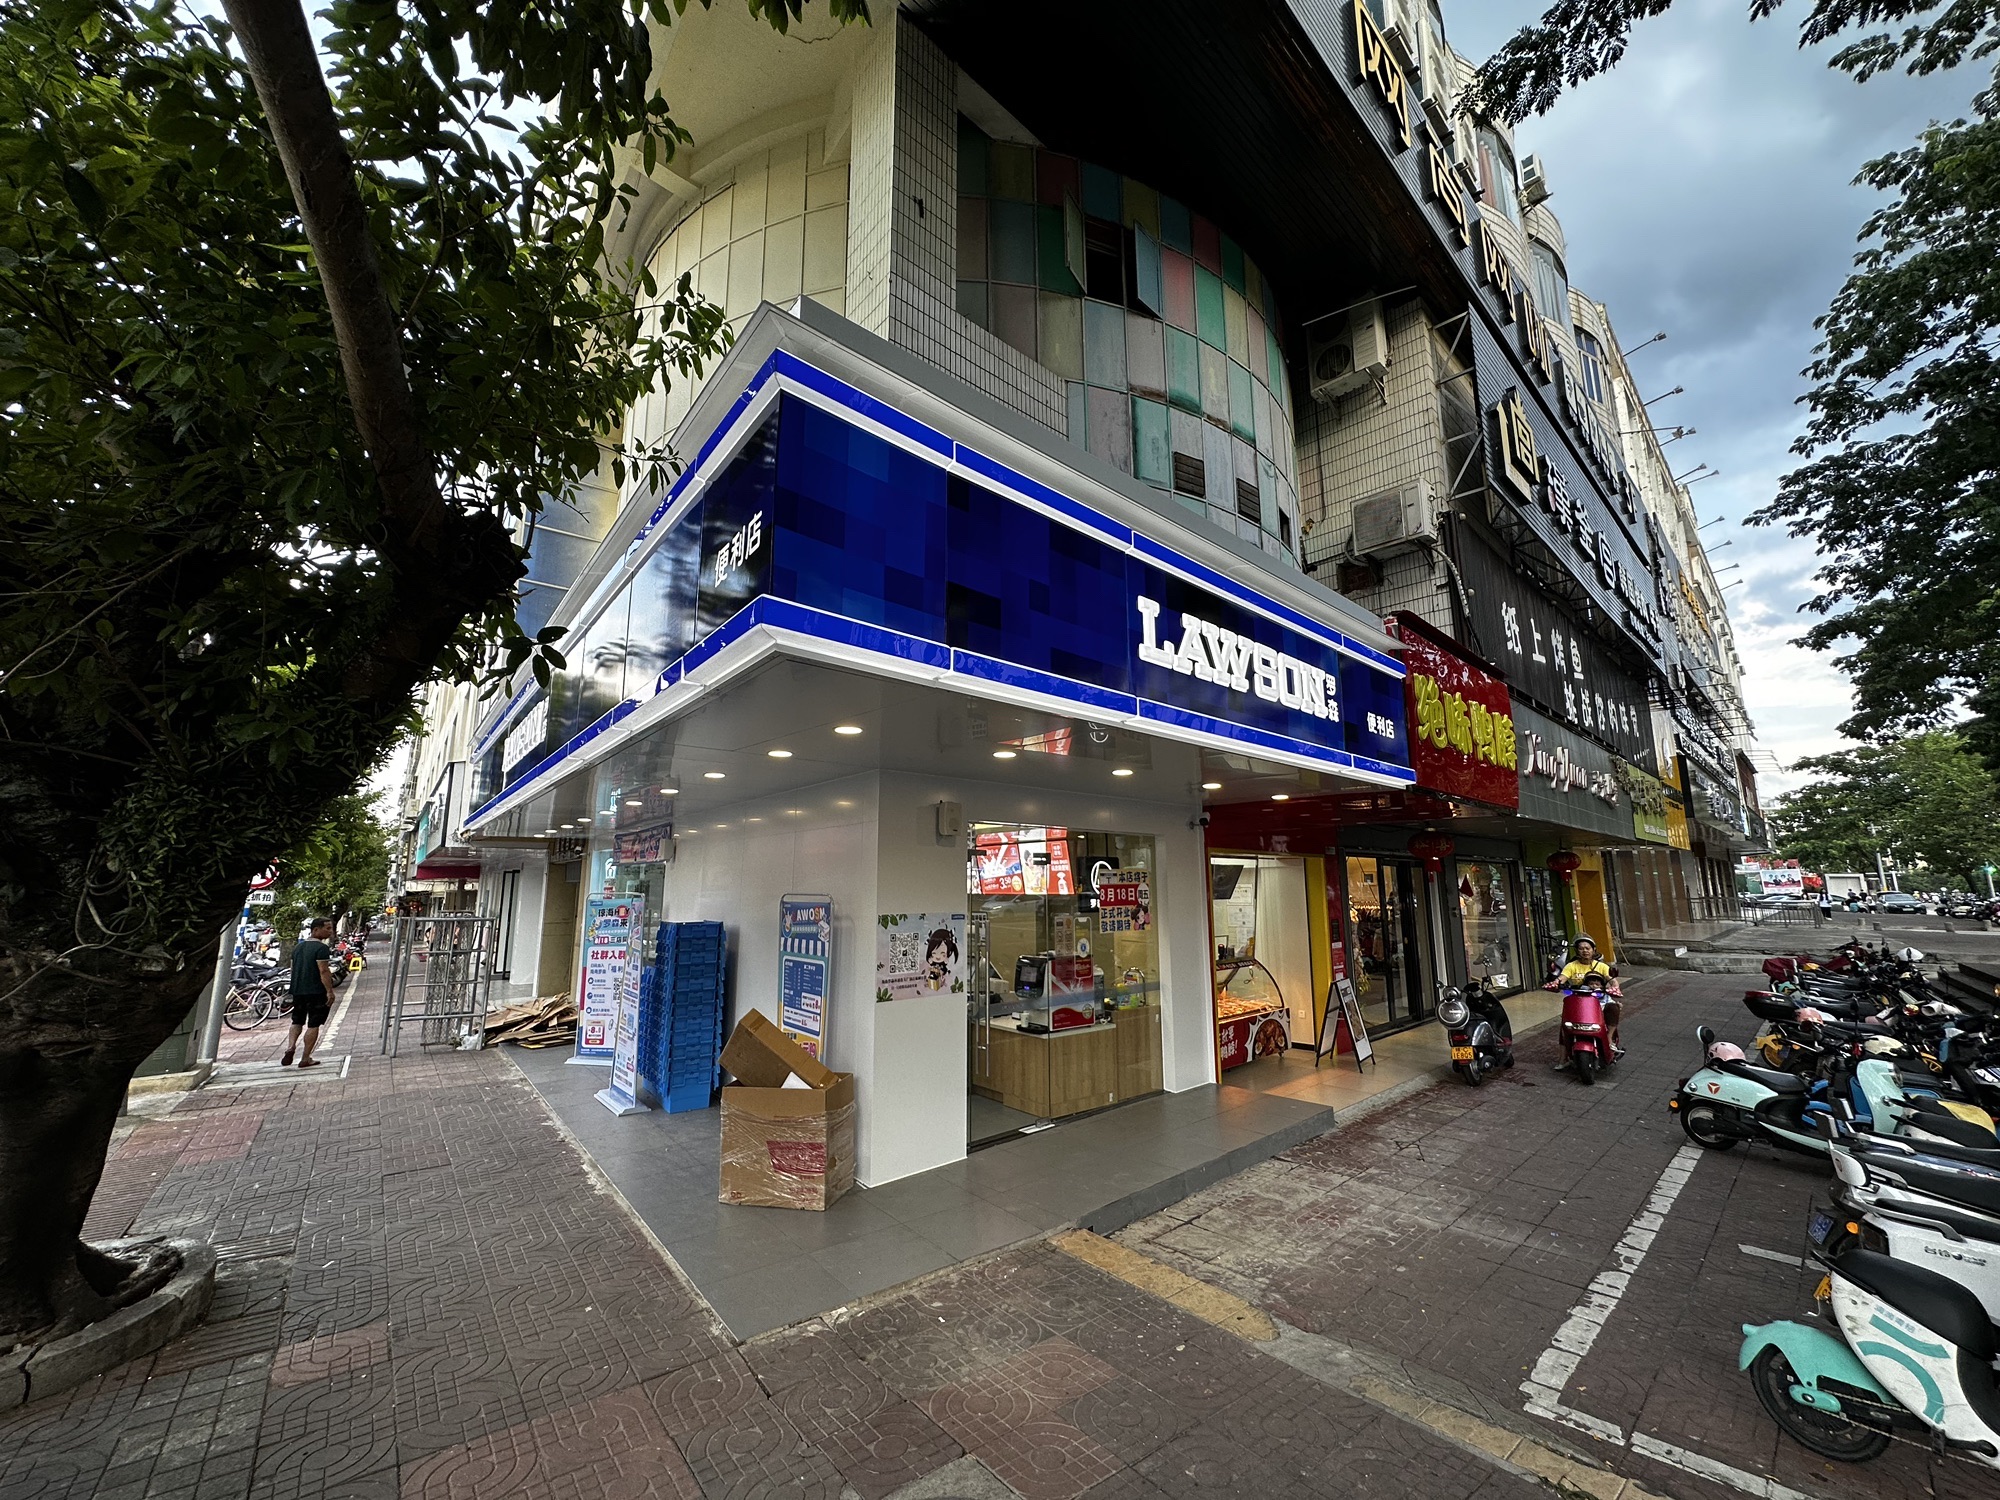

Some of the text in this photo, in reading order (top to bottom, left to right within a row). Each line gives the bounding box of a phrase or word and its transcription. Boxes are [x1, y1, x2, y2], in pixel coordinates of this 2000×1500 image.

[714, 510, 764, 588] 便利店
[1501, 601, 1585, 680] 纸上烤鱼
[1136, 595, 1328, 720] LAWSON
[1325, 673, 1340, 723] 罗森
[1366, 711, 1395, 739] 便利店
[1413, 672, 1518, 771] 绝味鸭脖
[1118, 871, 1148, 883] 本店将于
[248, 893, 272, 902] 抓拍
[1099, 888, 1135, 902] 8月18日
[1100, 907, 1131, 919] 正式开业
[1100, 919, 1131, 933] 敬请期待
[590, 950, 627, 960] 社群入群
